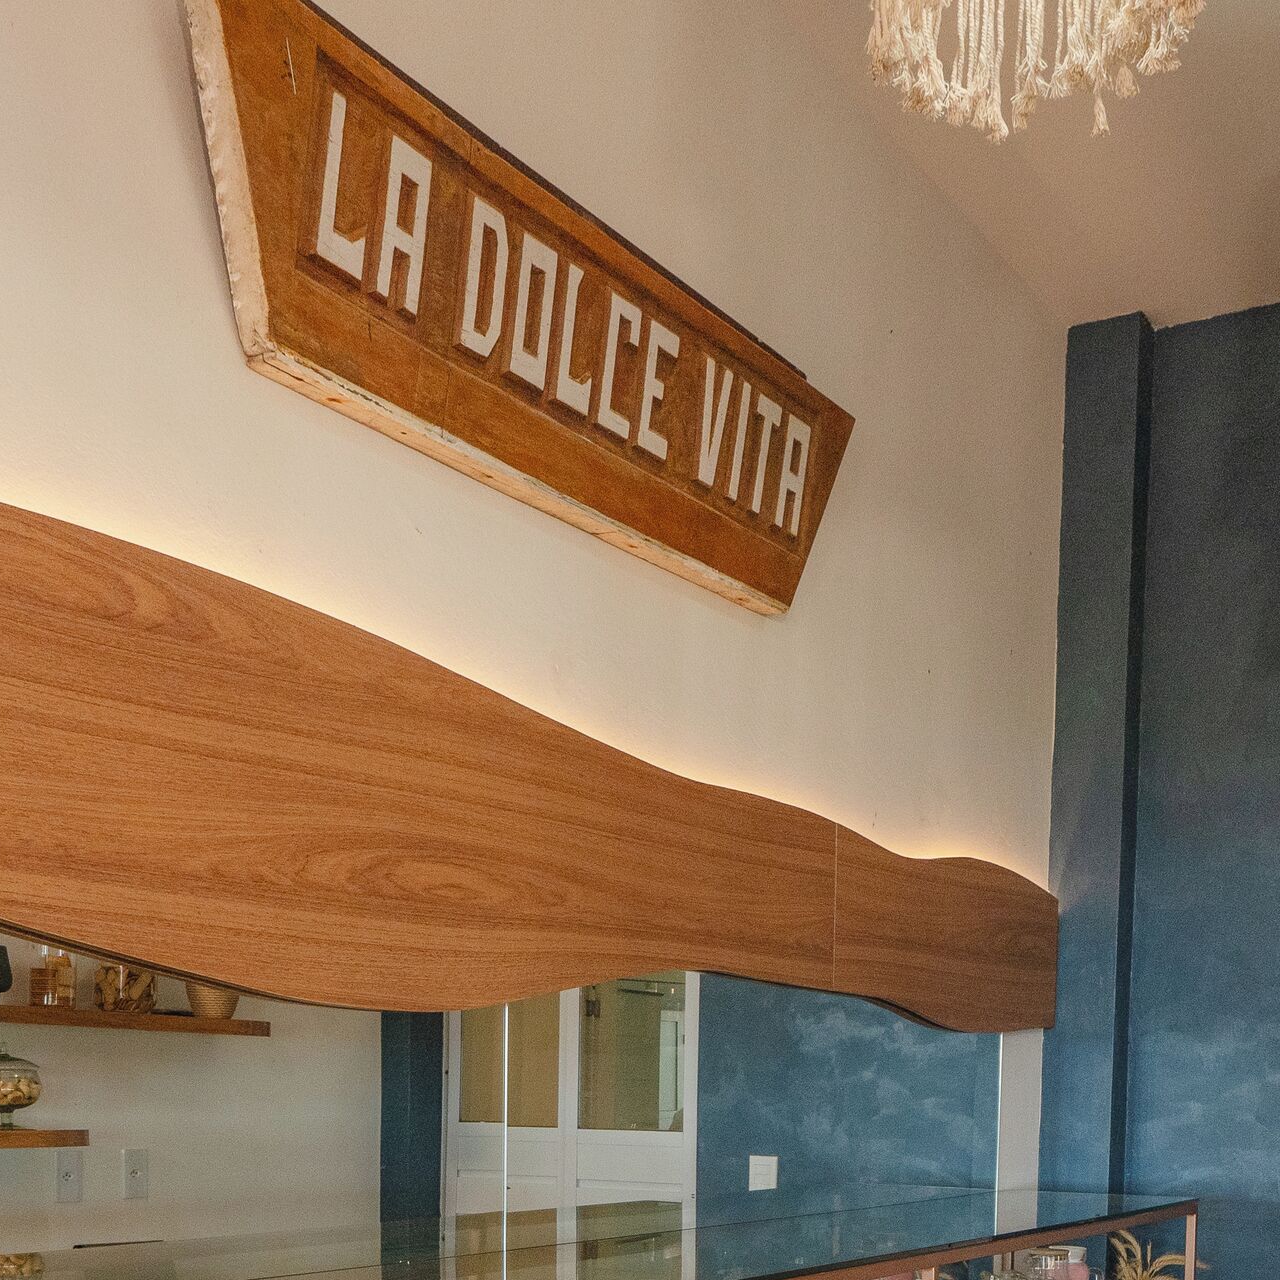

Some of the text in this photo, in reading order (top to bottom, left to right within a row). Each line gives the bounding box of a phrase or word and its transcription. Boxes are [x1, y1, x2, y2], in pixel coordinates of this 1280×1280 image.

[315, 91, 812, 538] LA DOLCE VITA
